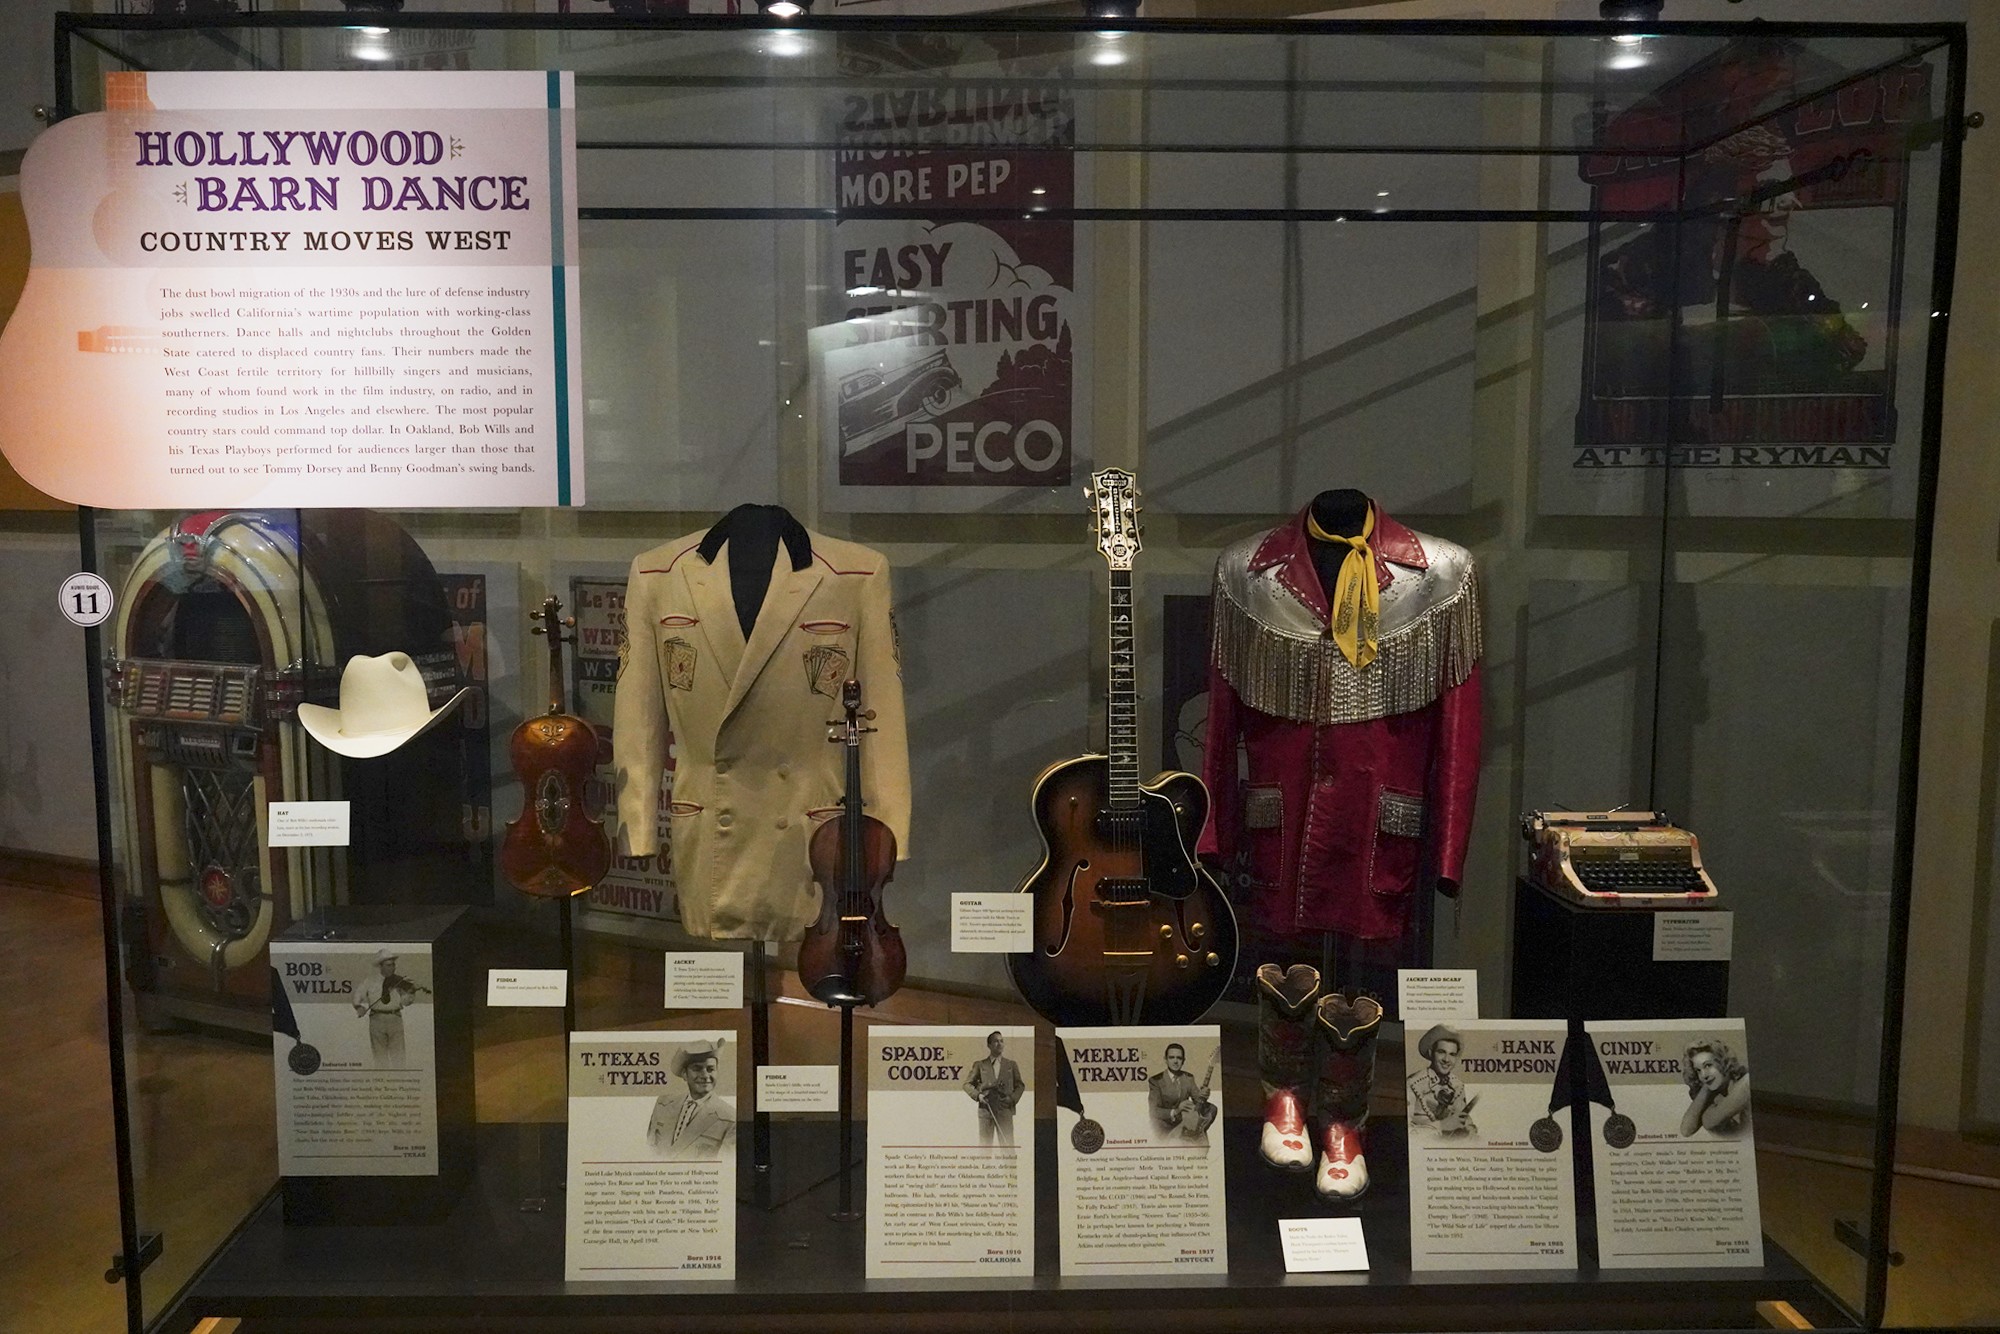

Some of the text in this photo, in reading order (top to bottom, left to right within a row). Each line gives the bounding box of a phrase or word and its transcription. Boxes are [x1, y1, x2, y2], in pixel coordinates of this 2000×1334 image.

[135, 130, 444, 167] HOLLYWOOD
[841, 159, 1011, 208] MORE PEP
[197, 176, 530, 212] BARN DANCE
[140, 231, 511, 252] COUNTRY MOVES WEST
[844, 242, 953, 292] EASY
[159, 286, 532, 301] The dust bowl migration of the 1930s and the lure of defense industry
[159, 305, 532, 322] jobs swelled California's wartime population with working-class
[844, 295, 1059, 348] STARTING
[161, 325, 532, 340] southerners. Dance halls and nightclubs throughout the Golden
[162, 345, 533, 361] State catered to displaced country fans. Their numbers made the
[163, 365, 534, 380] West Coast fertile territory for hillbilly singers and musicians,
[165, 384, 534, 400] many of whom found work in the film industry, on radio, and in
[166, 404, 535, 419] recording studios in Los Angeles and elsewhere. The most popular
[167, 423, 535, 439] country stars could command top dollar. In Oakland, Bob Wills and
[168, 443, 536, 458] his Texas Playboys performed for audiences larger than those that
[905, 419, 1064, 474] PECO
[1574, 446, 1891, 467] AT THE RYMAN
[169, 461, 536, 477] turned out to see Tommy Dorsey and Benny Goodman's swing bands.
[456, 579, 481, 609] of
[72, 592, 101, 615] 11
[285, 962, 322, 977] BOB
[292, 979, 353, 994] WILLS
[881, 1046, 945, 1062] SPADE
[1501, 1040, 1556, 1054] HANK
[1600, 1041, 1654, 1056] CINDY
[581, 1052, 660, 1066] T. TEXAS
[1073, 1048, 1140, 1063] MERLE
[887, 1065, 964, 1081] COOLEY
[1078, 1066, 1148, 1082] TRAVIS
[1461, 1059, 1557, 1074] THOMPSON
[1605, 1059, 1682, 1075] WALKER
[607, 1070, 668, 1086] TYLER
[680, 1262, 722, 1270] ARKANSAS
[1174, 1256, 1215, 1264] KENTUCKY
